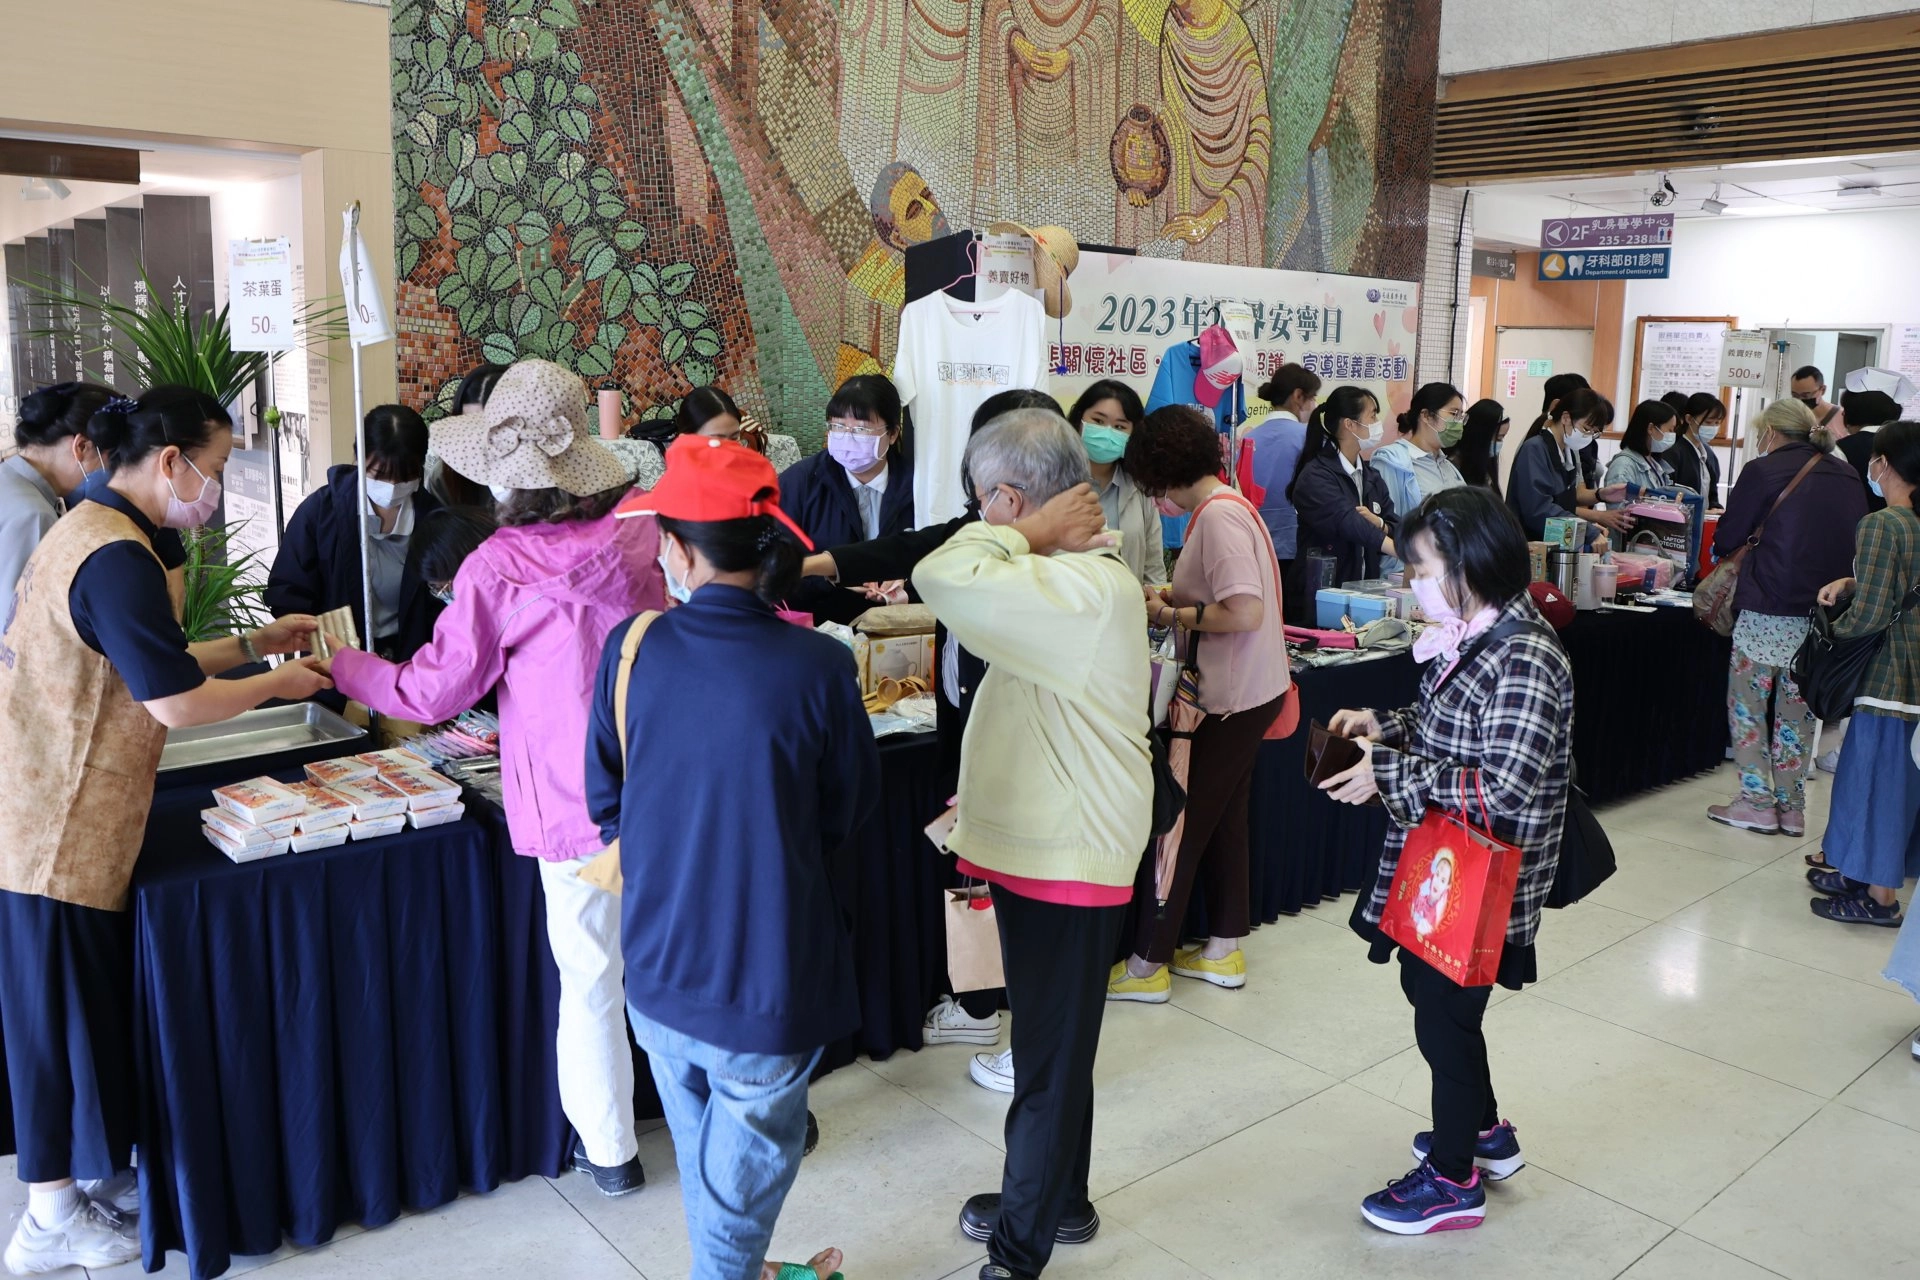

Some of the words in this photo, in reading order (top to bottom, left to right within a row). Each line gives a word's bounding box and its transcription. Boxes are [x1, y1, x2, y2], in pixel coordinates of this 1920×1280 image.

[1592, 217, 1670, 231] 乳房醫學中心
[1571, 225, 1590, 240] 2F
[1586, 253, 1665, 268] 牙科部B1診間
[988, 269, 1030, 285] 義賣好物
[242, 280, 282, 297] 茶葉蛋
[251, 316, 277, 334] 50元
[1096, 295, 1343, 344] 2023年界安寧日
[1728, 348, 1762, 359] 義賣好物
[1303, 353, 1407, 379] 宣導暨義賣活動
[1651, 539, 1685, 550] POTECTOR
[1663, 535, 1686, 544] LAPTOP
